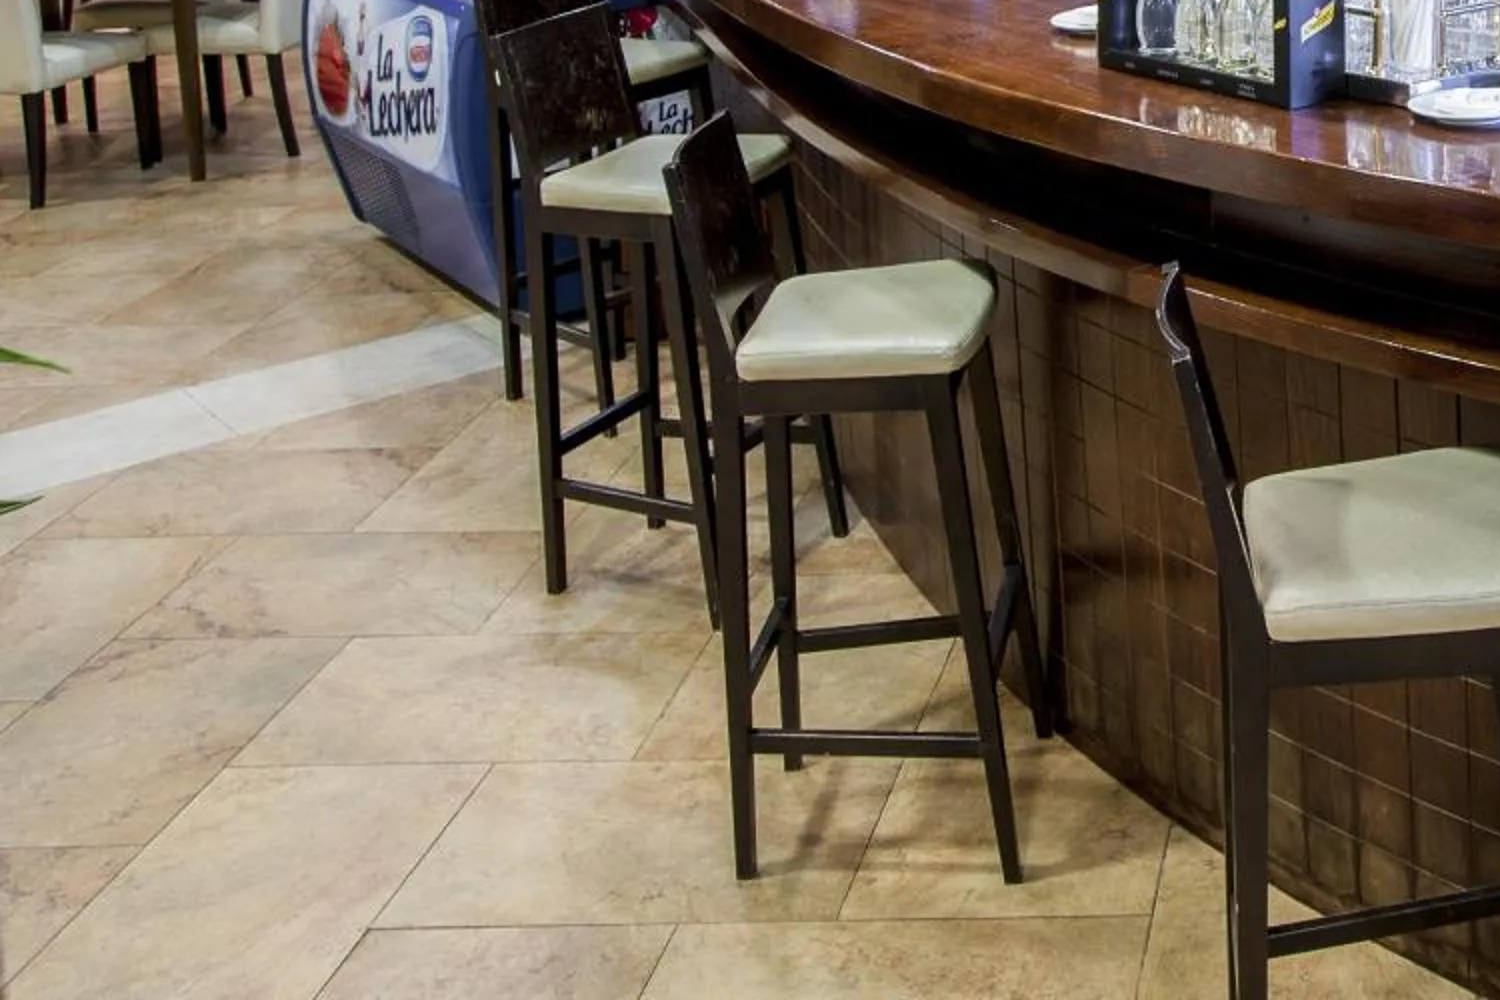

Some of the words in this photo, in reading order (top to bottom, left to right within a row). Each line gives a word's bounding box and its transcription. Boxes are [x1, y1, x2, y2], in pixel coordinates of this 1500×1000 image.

[377, 33, 393, 81] La
[366, 69, 437, 142] Lechera
[659, 101, 678, 122] La
